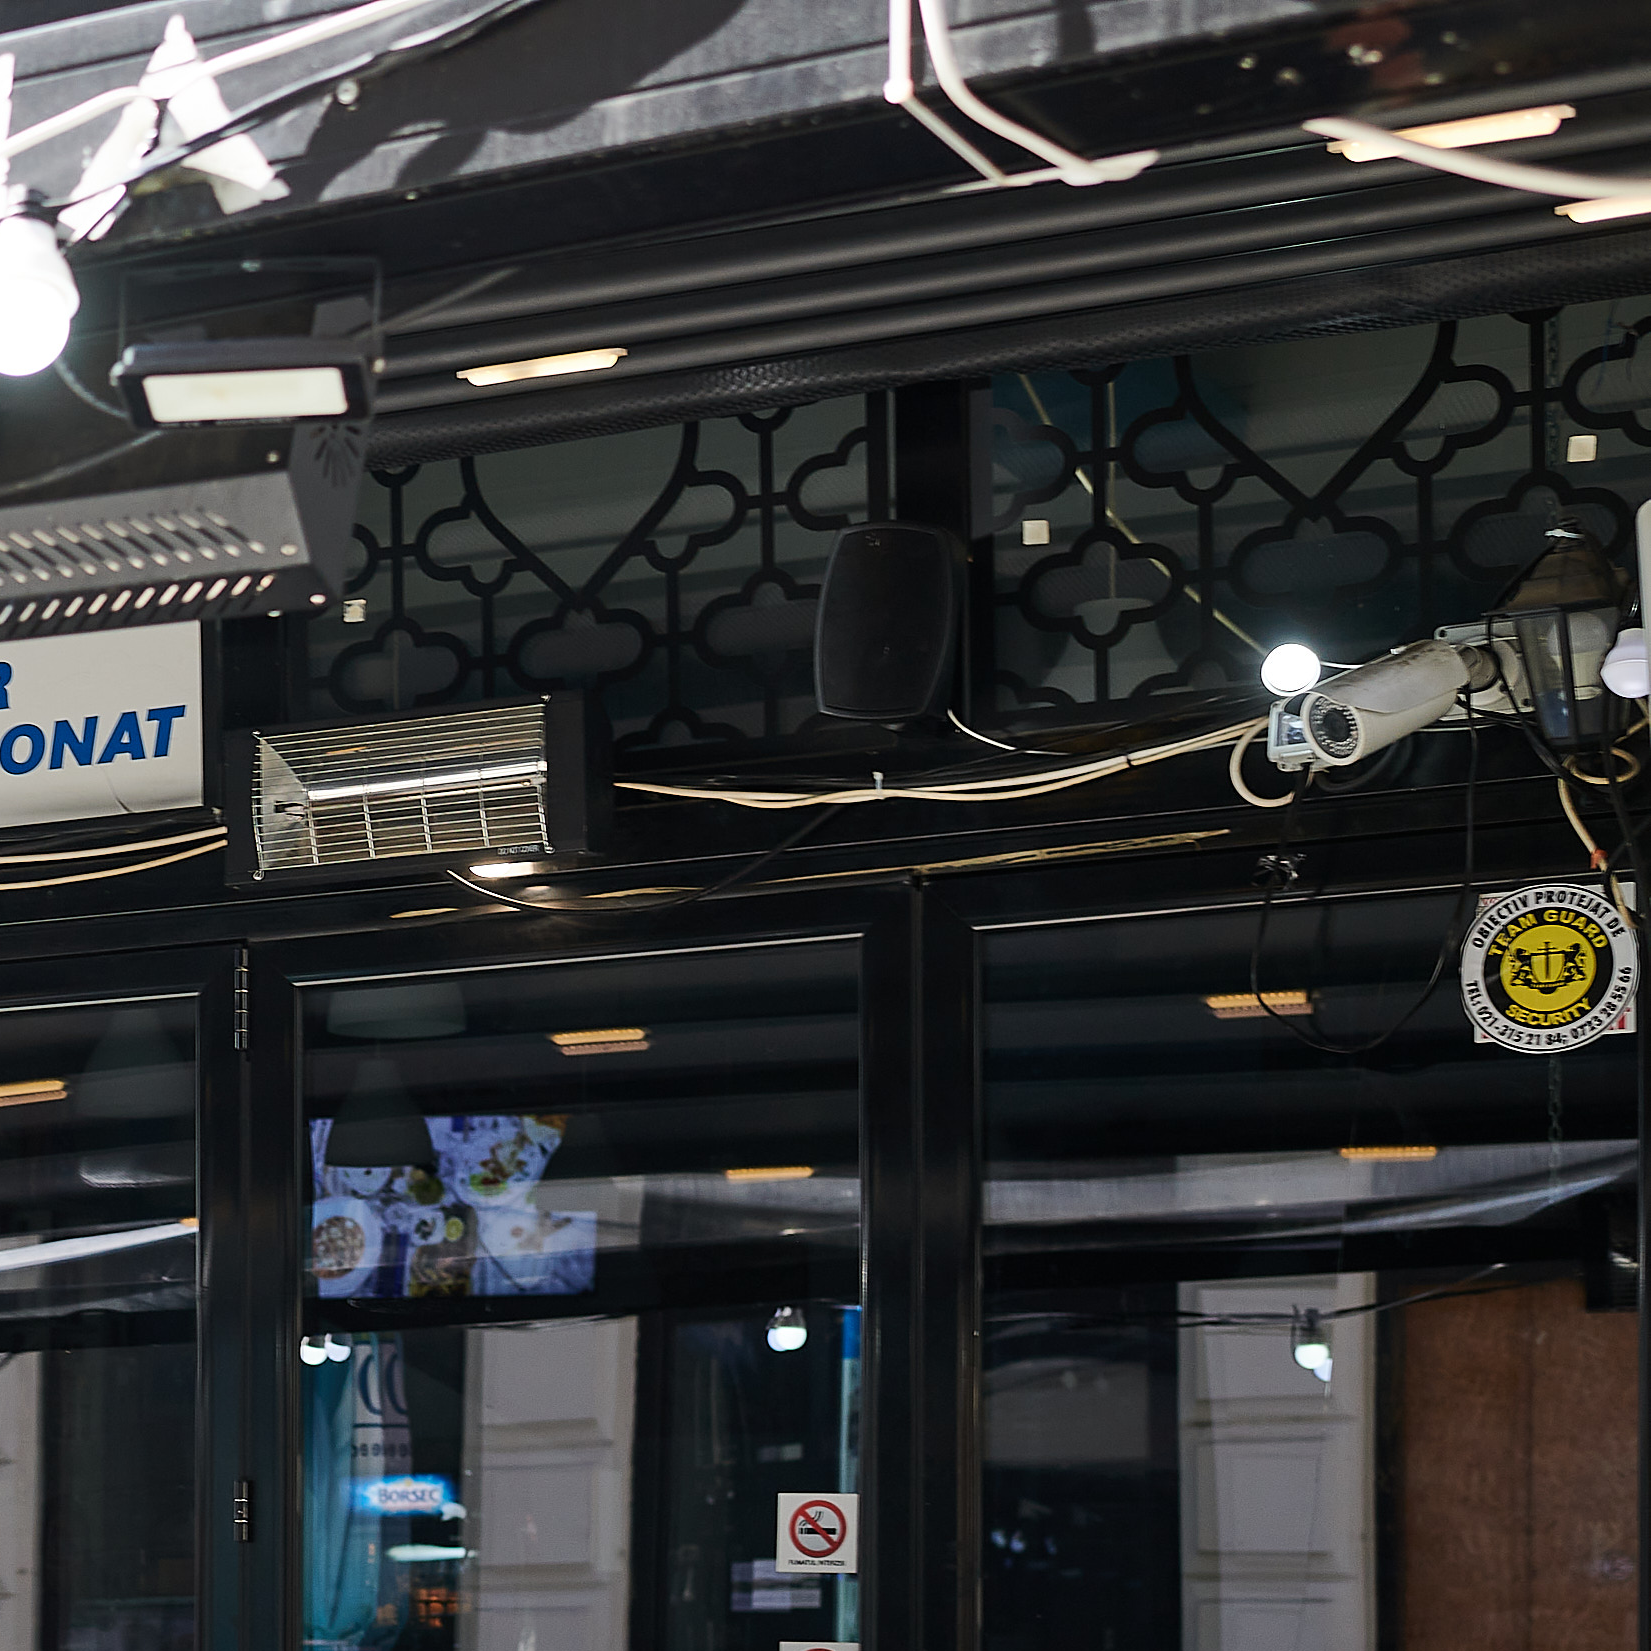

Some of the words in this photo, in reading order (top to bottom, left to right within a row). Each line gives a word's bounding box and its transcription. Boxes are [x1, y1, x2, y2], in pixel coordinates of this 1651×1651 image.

[1488, 913, 1538, 956] TEAM
[1543, 909, 1609, 948] GUARD
[1535, 891, 1611, 919] PROTEJAT
[1606, 916, 1626, 938] DE
[1504, 997, 1591, 1026] SECURITY
[378, 1487, 441, 1503] BORSEC
